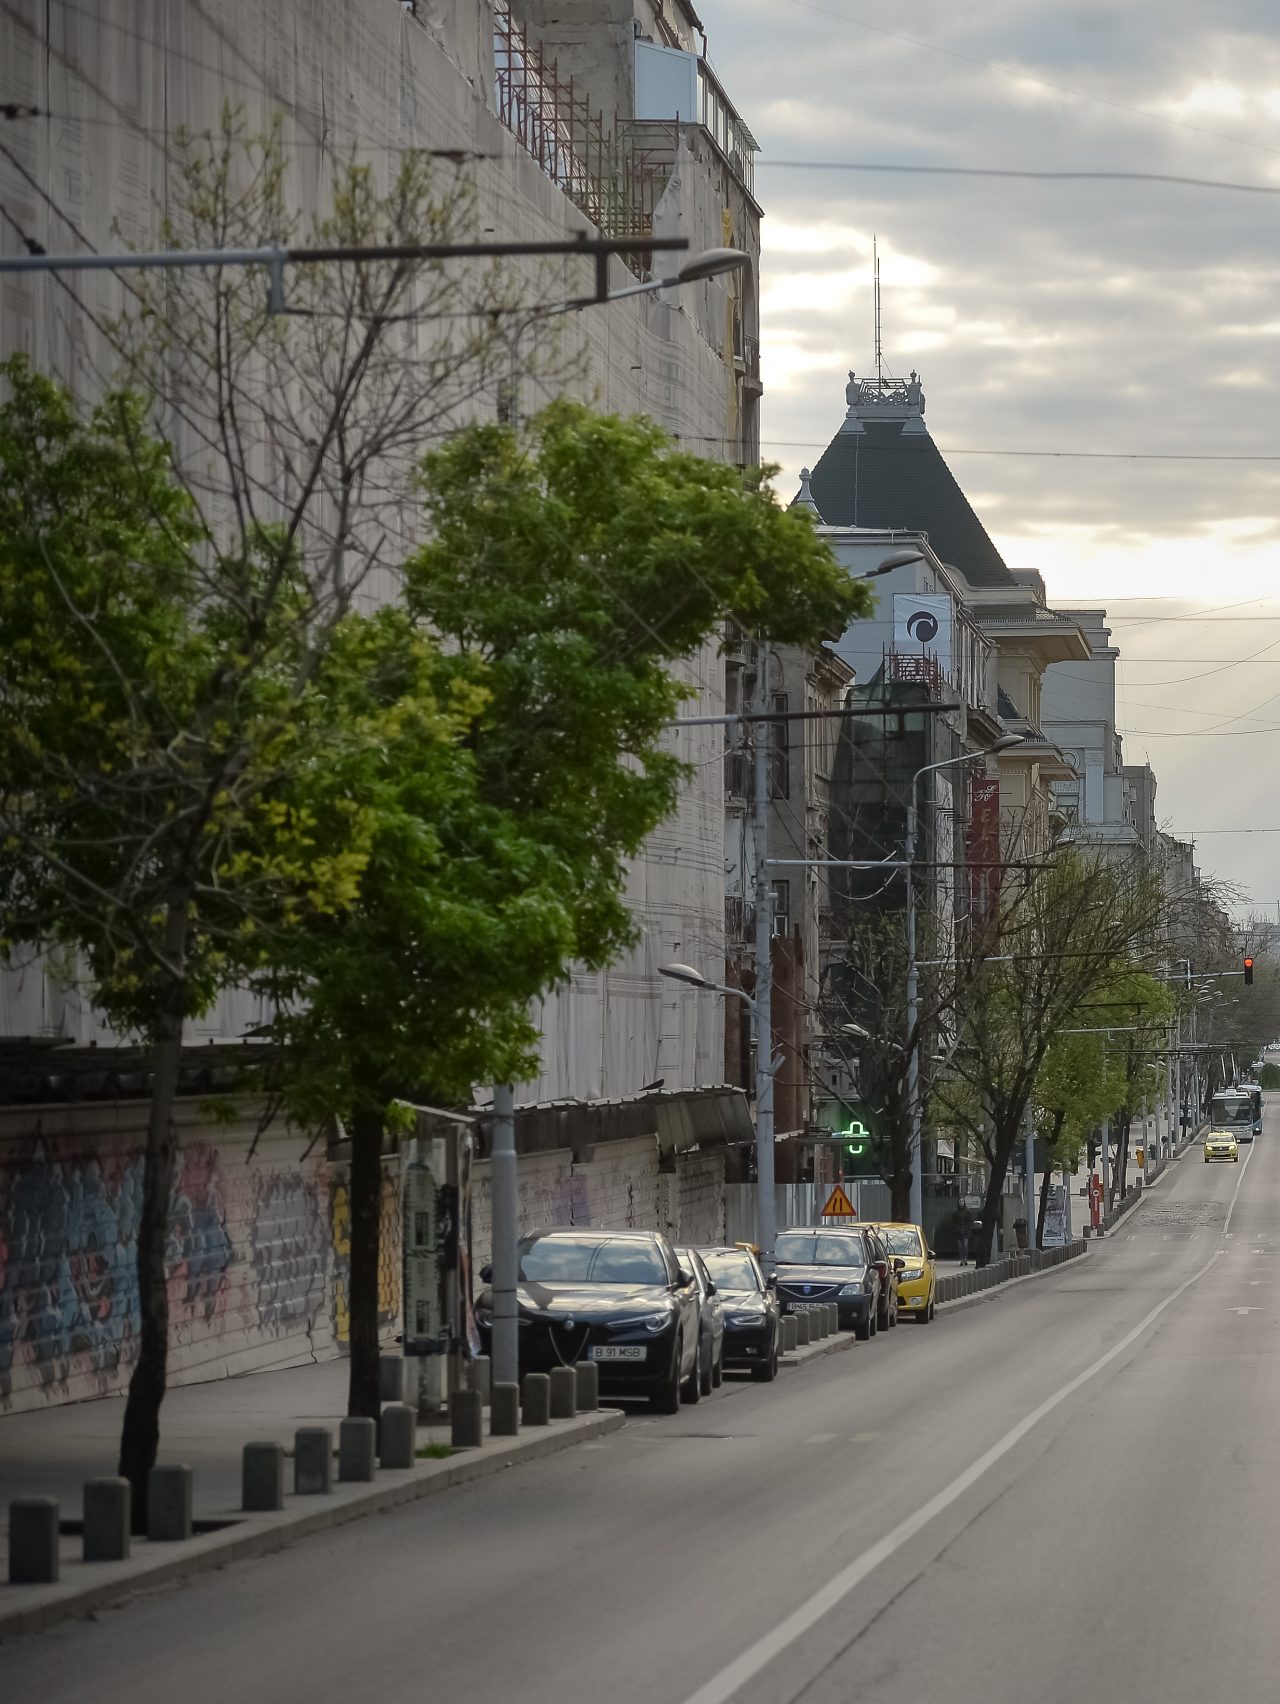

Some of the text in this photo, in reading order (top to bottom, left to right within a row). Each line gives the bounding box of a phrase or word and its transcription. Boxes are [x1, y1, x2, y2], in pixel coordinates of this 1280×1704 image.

[595, 1347, 640, 1358] B 91 MSB
